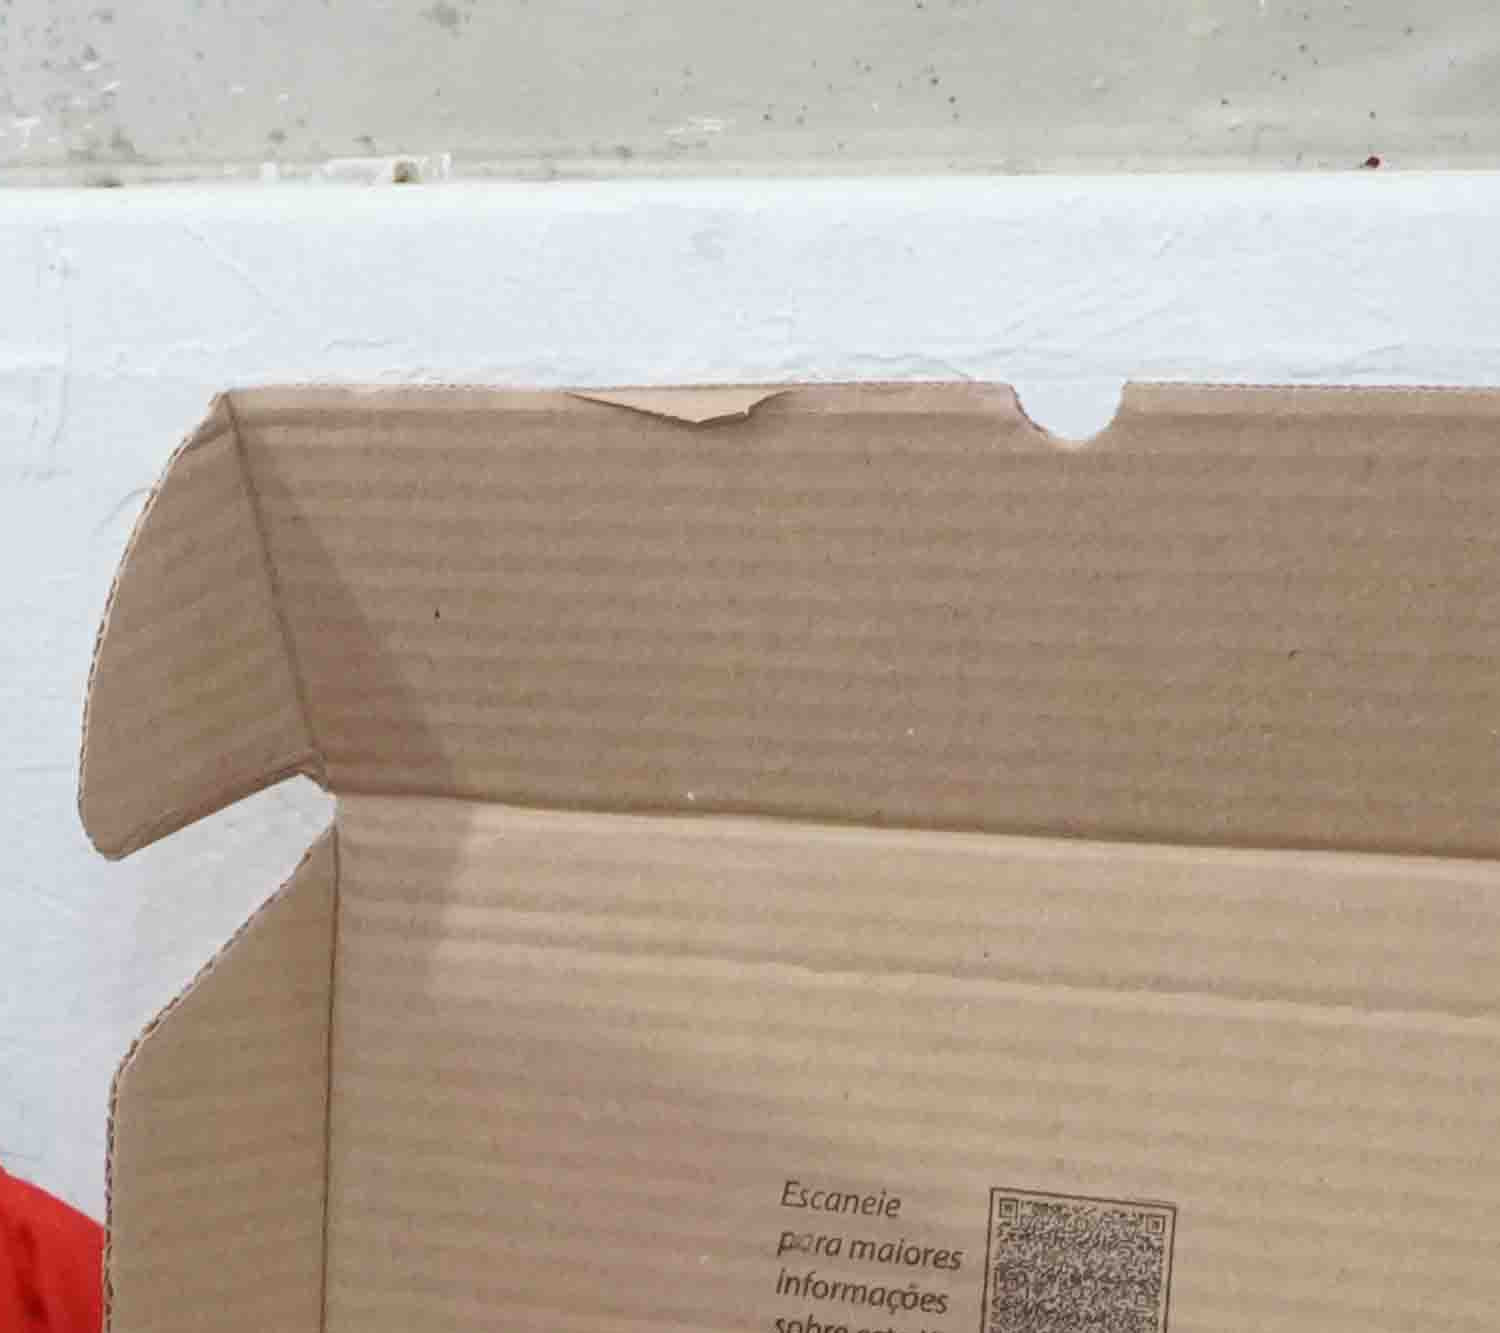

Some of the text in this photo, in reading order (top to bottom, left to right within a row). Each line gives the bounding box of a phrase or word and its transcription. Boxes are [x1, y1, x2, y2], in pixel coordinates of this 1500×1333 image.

[780, 1180, 902, 1219] Escaneie
[776, 1229, 963, 1271] para maiores
[775, 1269, 949, 1316] informações
